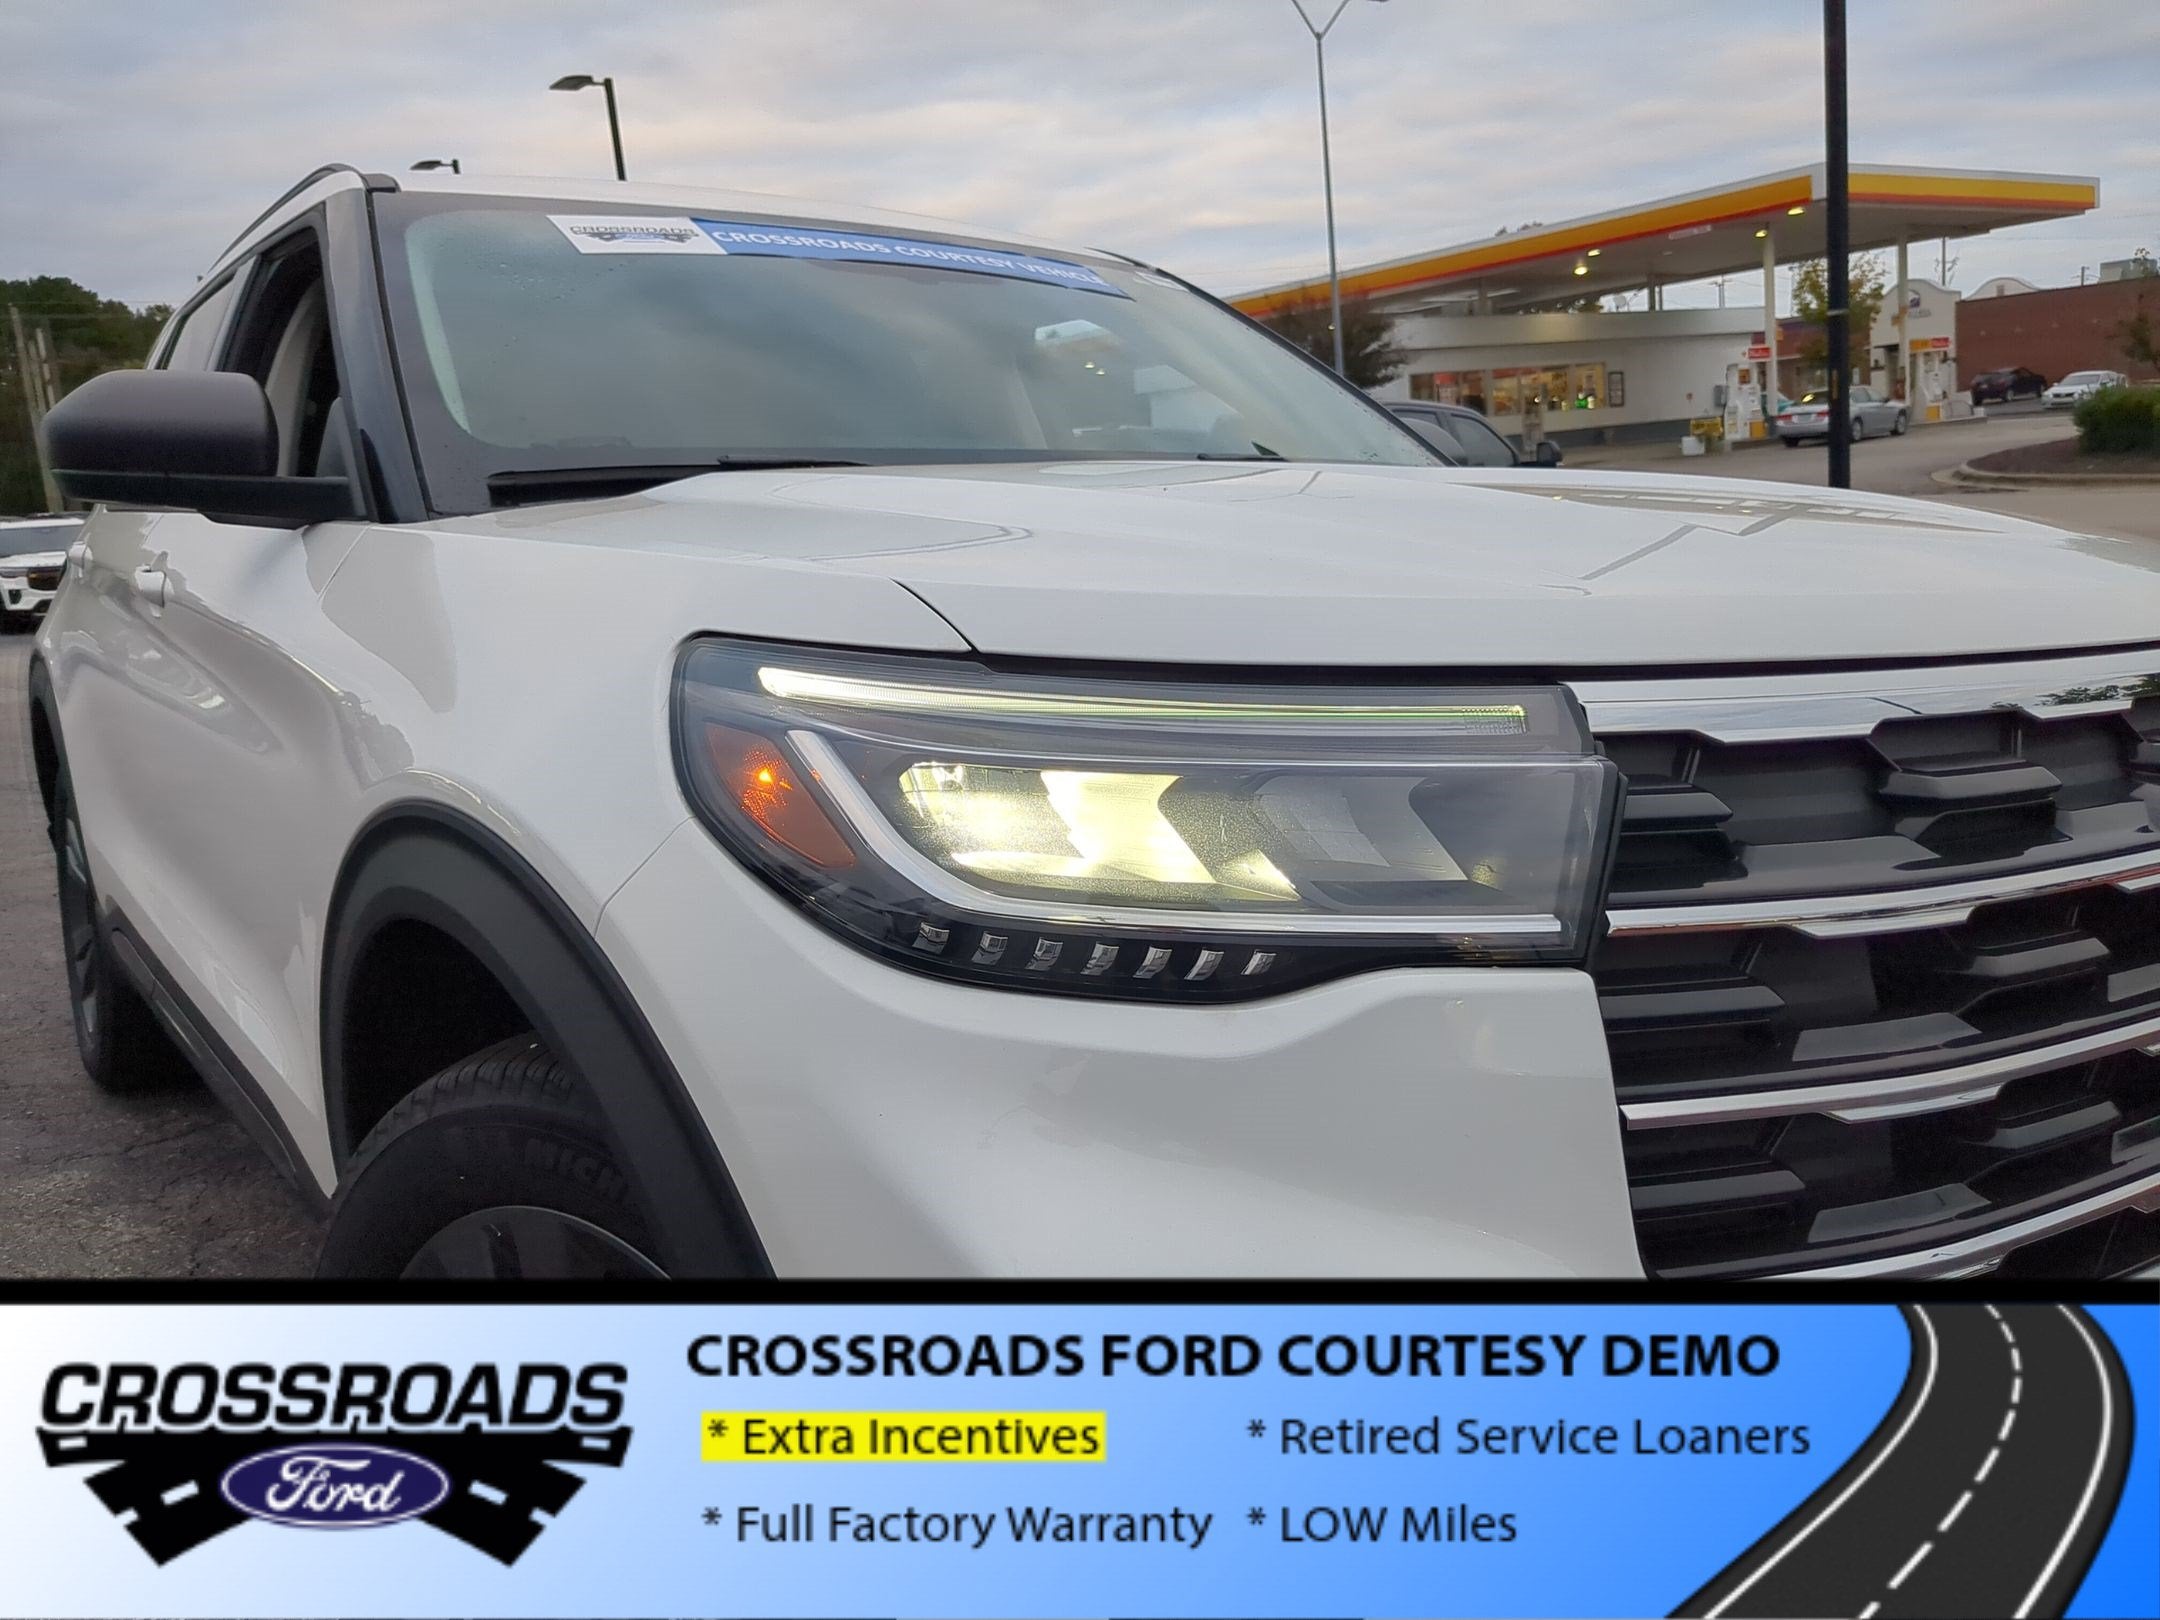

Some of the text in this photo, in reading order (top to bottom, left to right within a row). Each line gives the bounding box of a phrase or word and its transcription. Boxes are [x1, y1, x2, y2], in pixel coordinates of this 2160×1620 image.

[570, 225, 697, 235] CROSSROADS
[711, 231, 892, 253] CROSSROADS
[894, 245, 1014, 270] COURTESY
